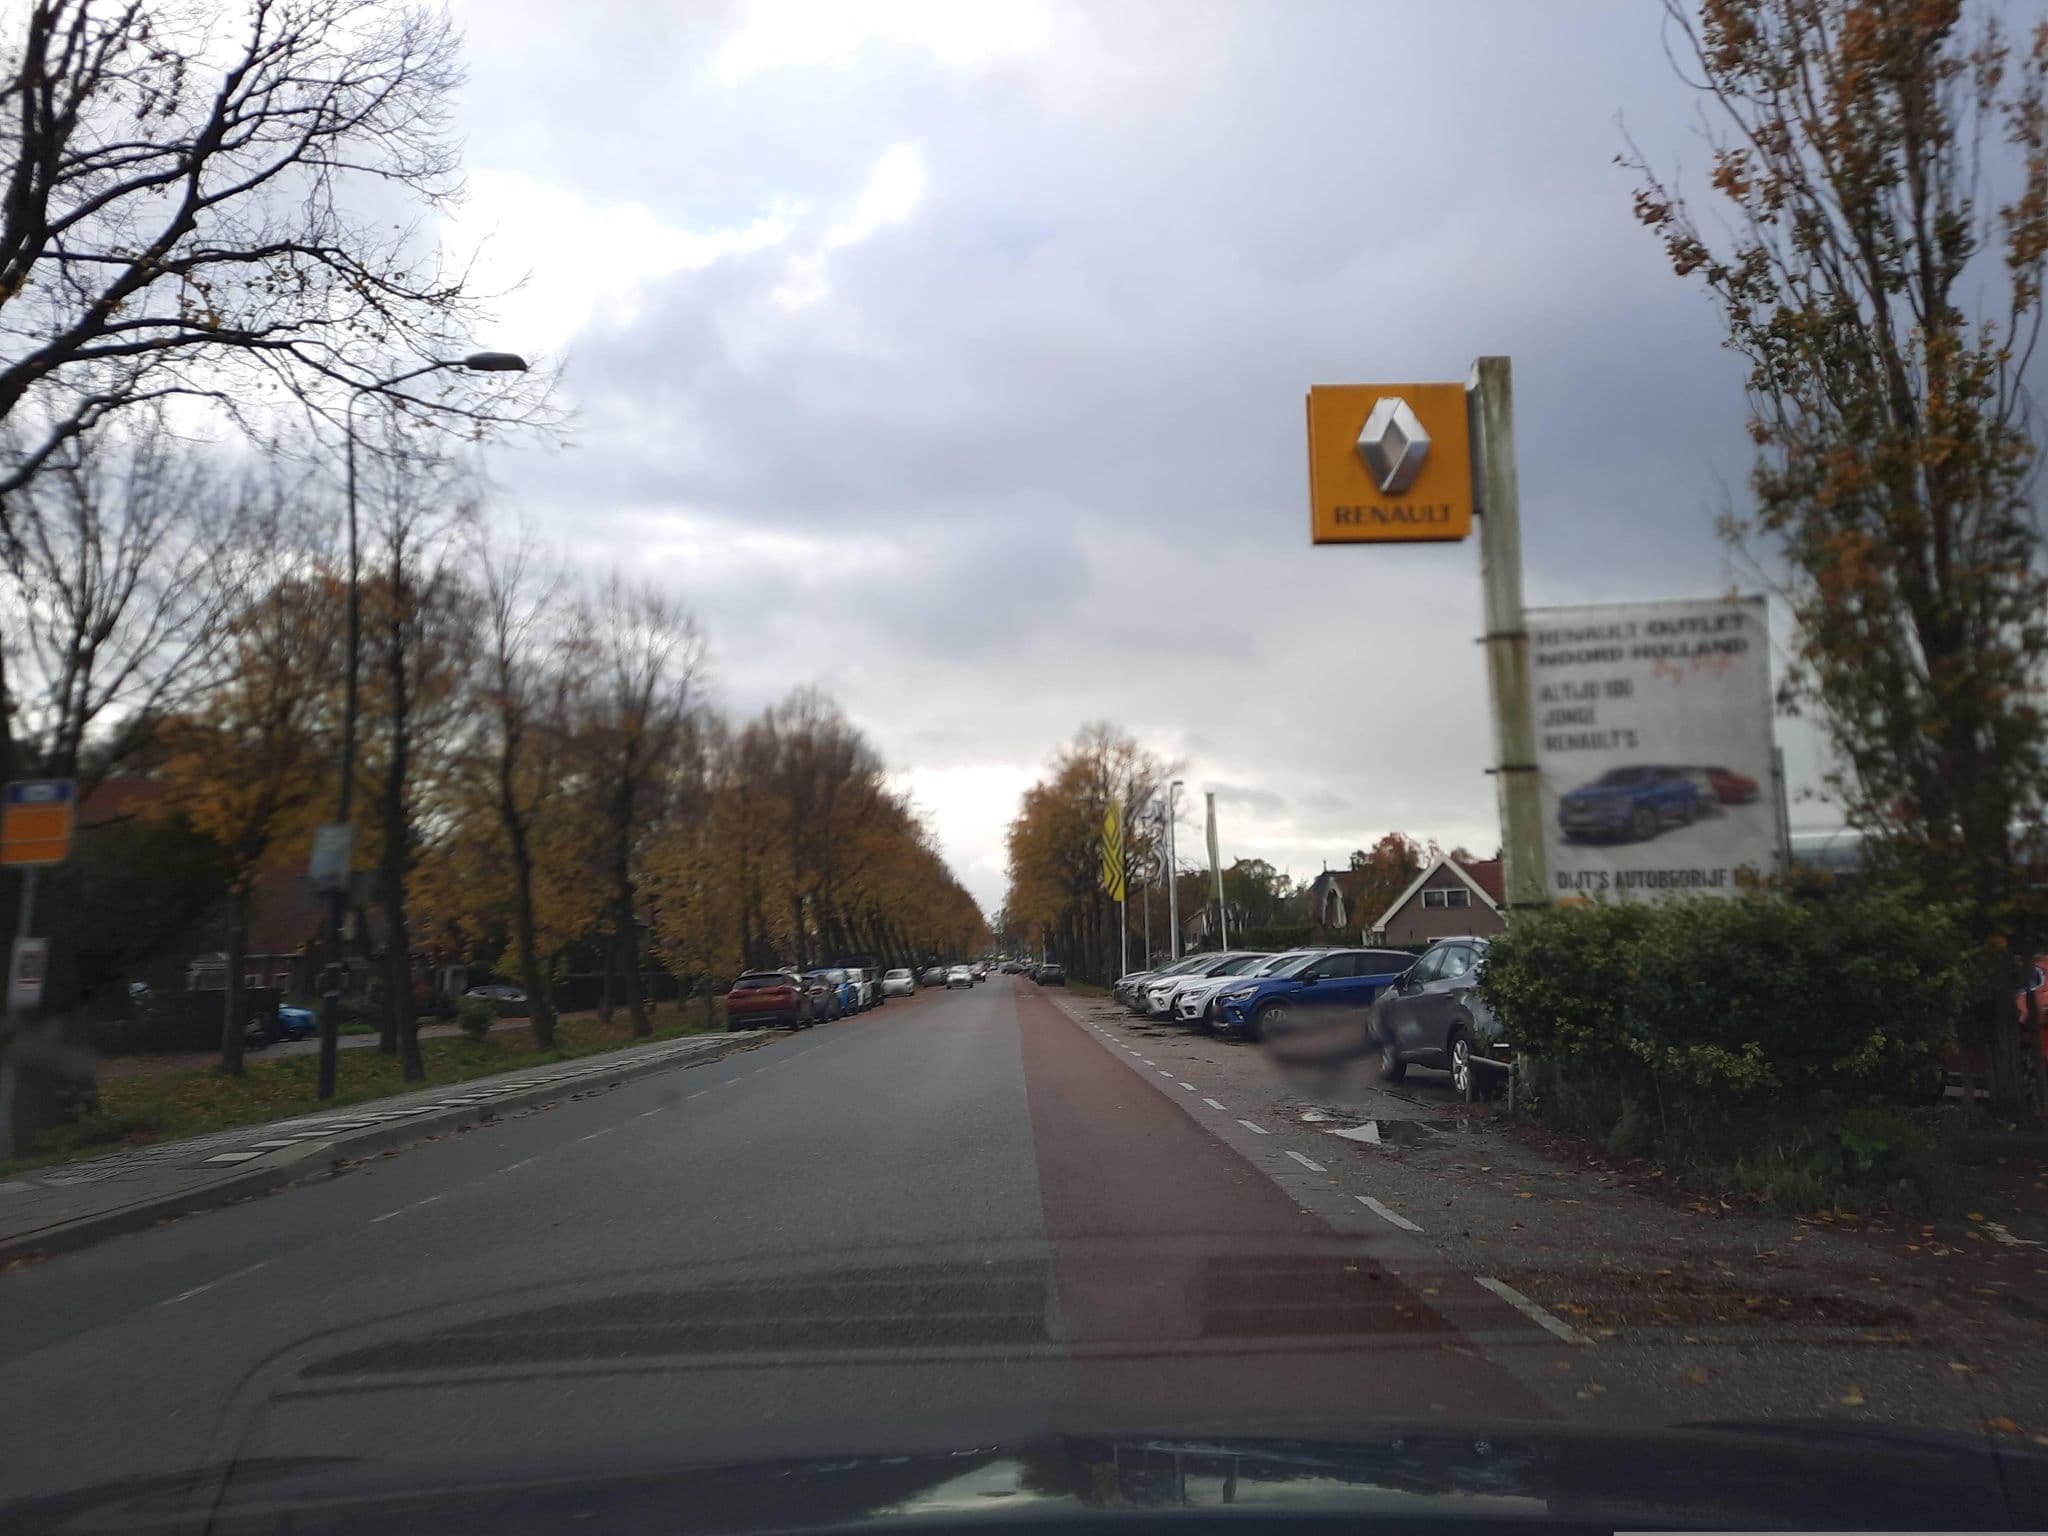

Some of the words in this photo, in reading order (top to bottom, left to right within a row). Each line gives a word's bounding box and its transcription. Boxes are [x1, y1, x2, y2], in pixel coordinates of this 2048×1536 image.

[1335, 505, 1454, 524] RENAULT
[1645, 615, 1744, 636] OUTLET
[1615, 869, 1728, 888] AUTOBEDRIJF
